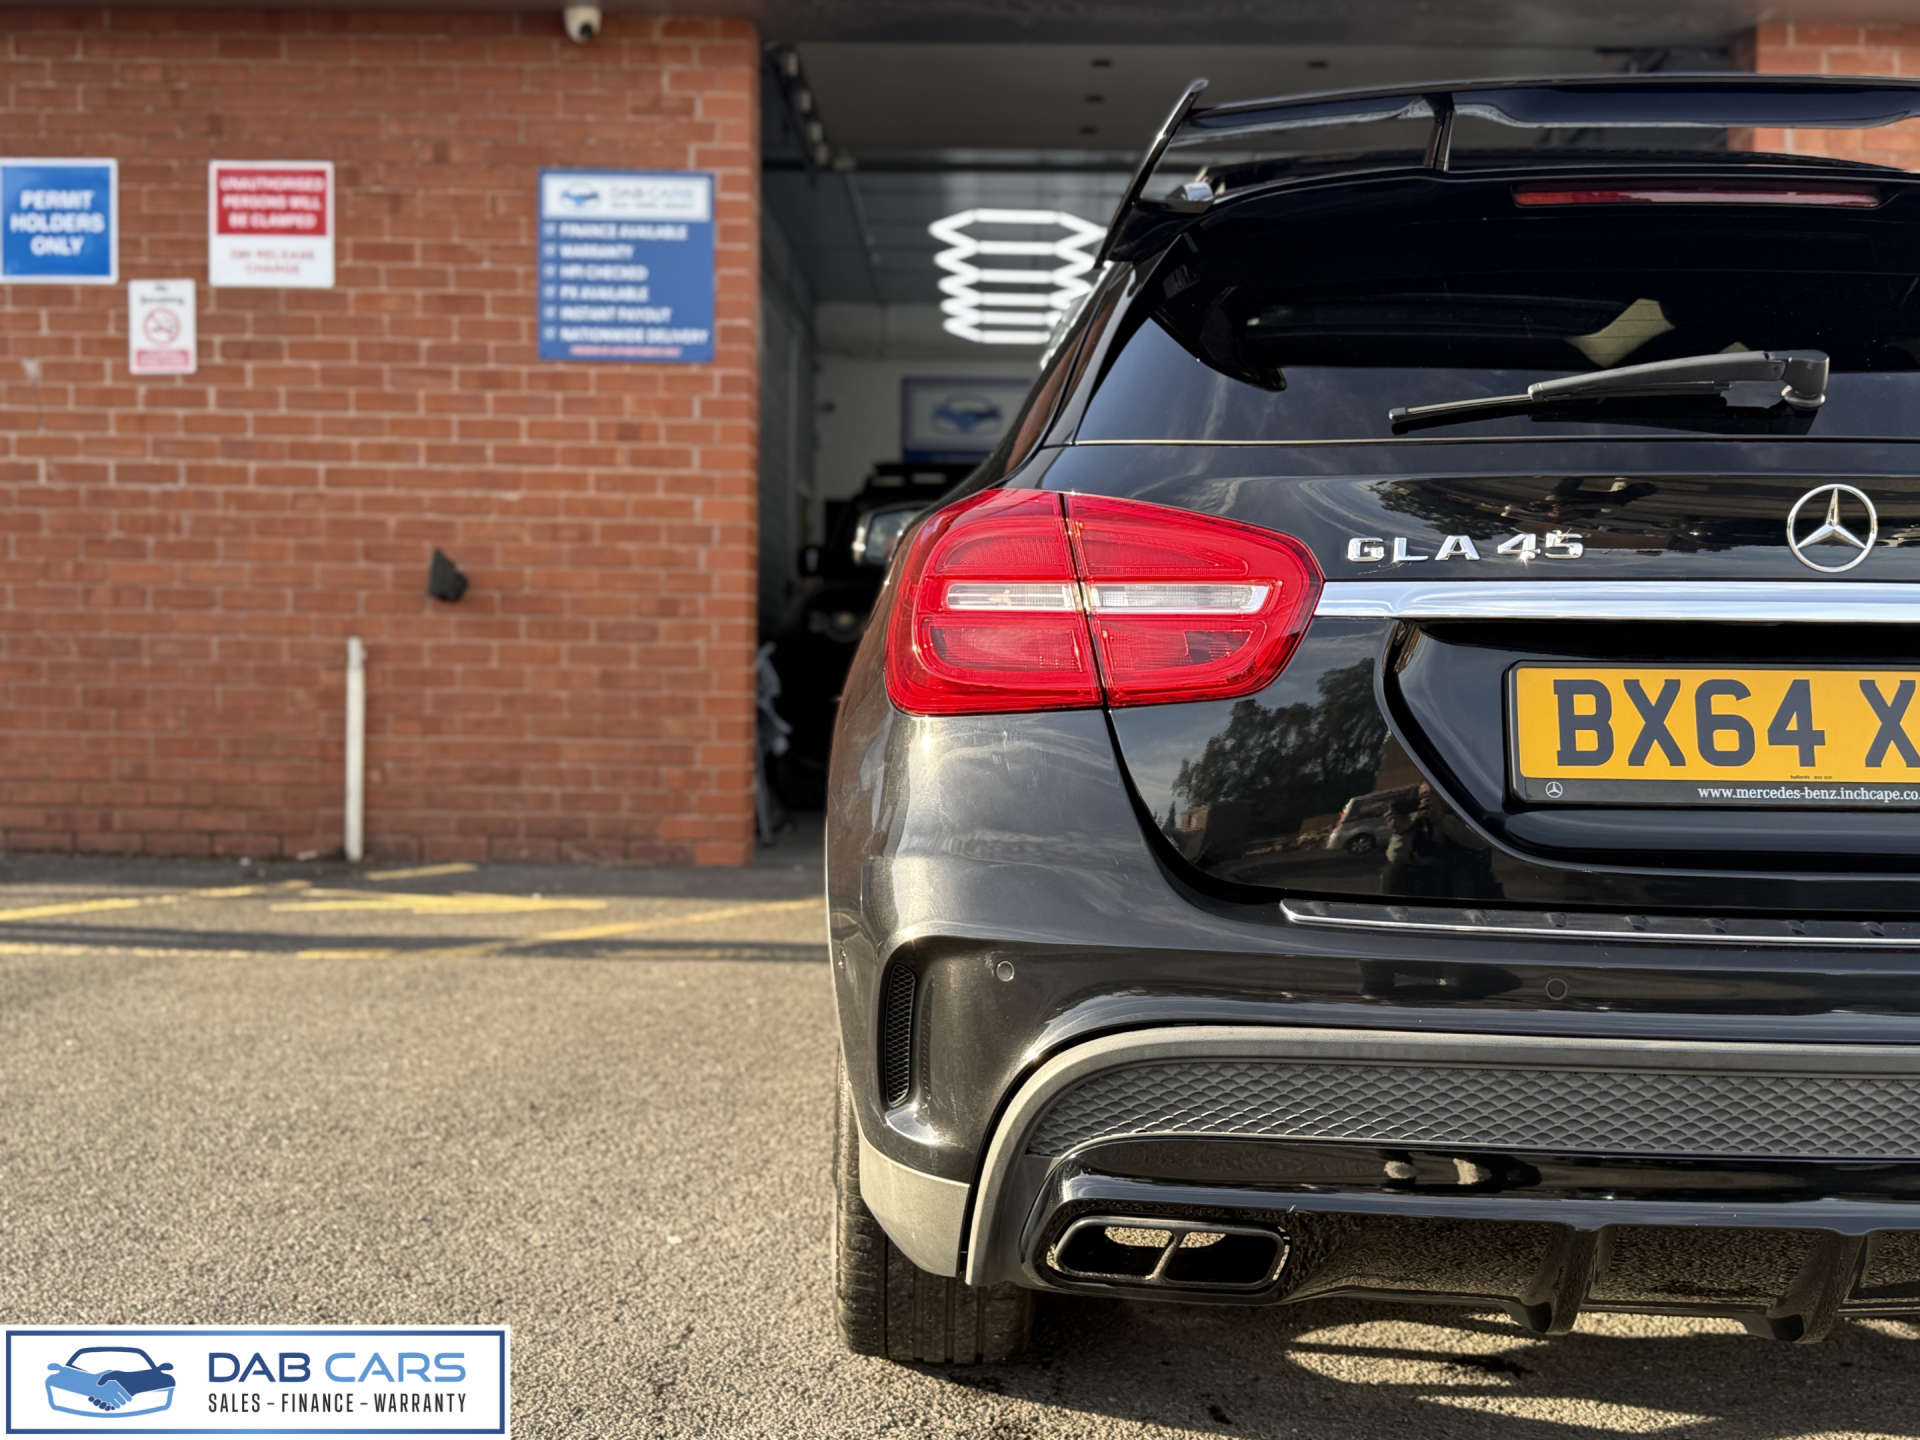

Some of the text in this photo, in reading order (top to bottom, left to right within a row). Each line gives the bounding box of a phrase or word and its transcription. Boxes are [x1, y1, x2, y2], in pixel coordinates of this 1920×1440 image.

[21, 190, 94, 209] PERMIT
[10, 213, 105, 233] HOLDERS
[30, 236, 84, 255] ONLY
[1347, 532, 1584, 562] GLA 45
[1553, 679, 1826, 767] BX64
